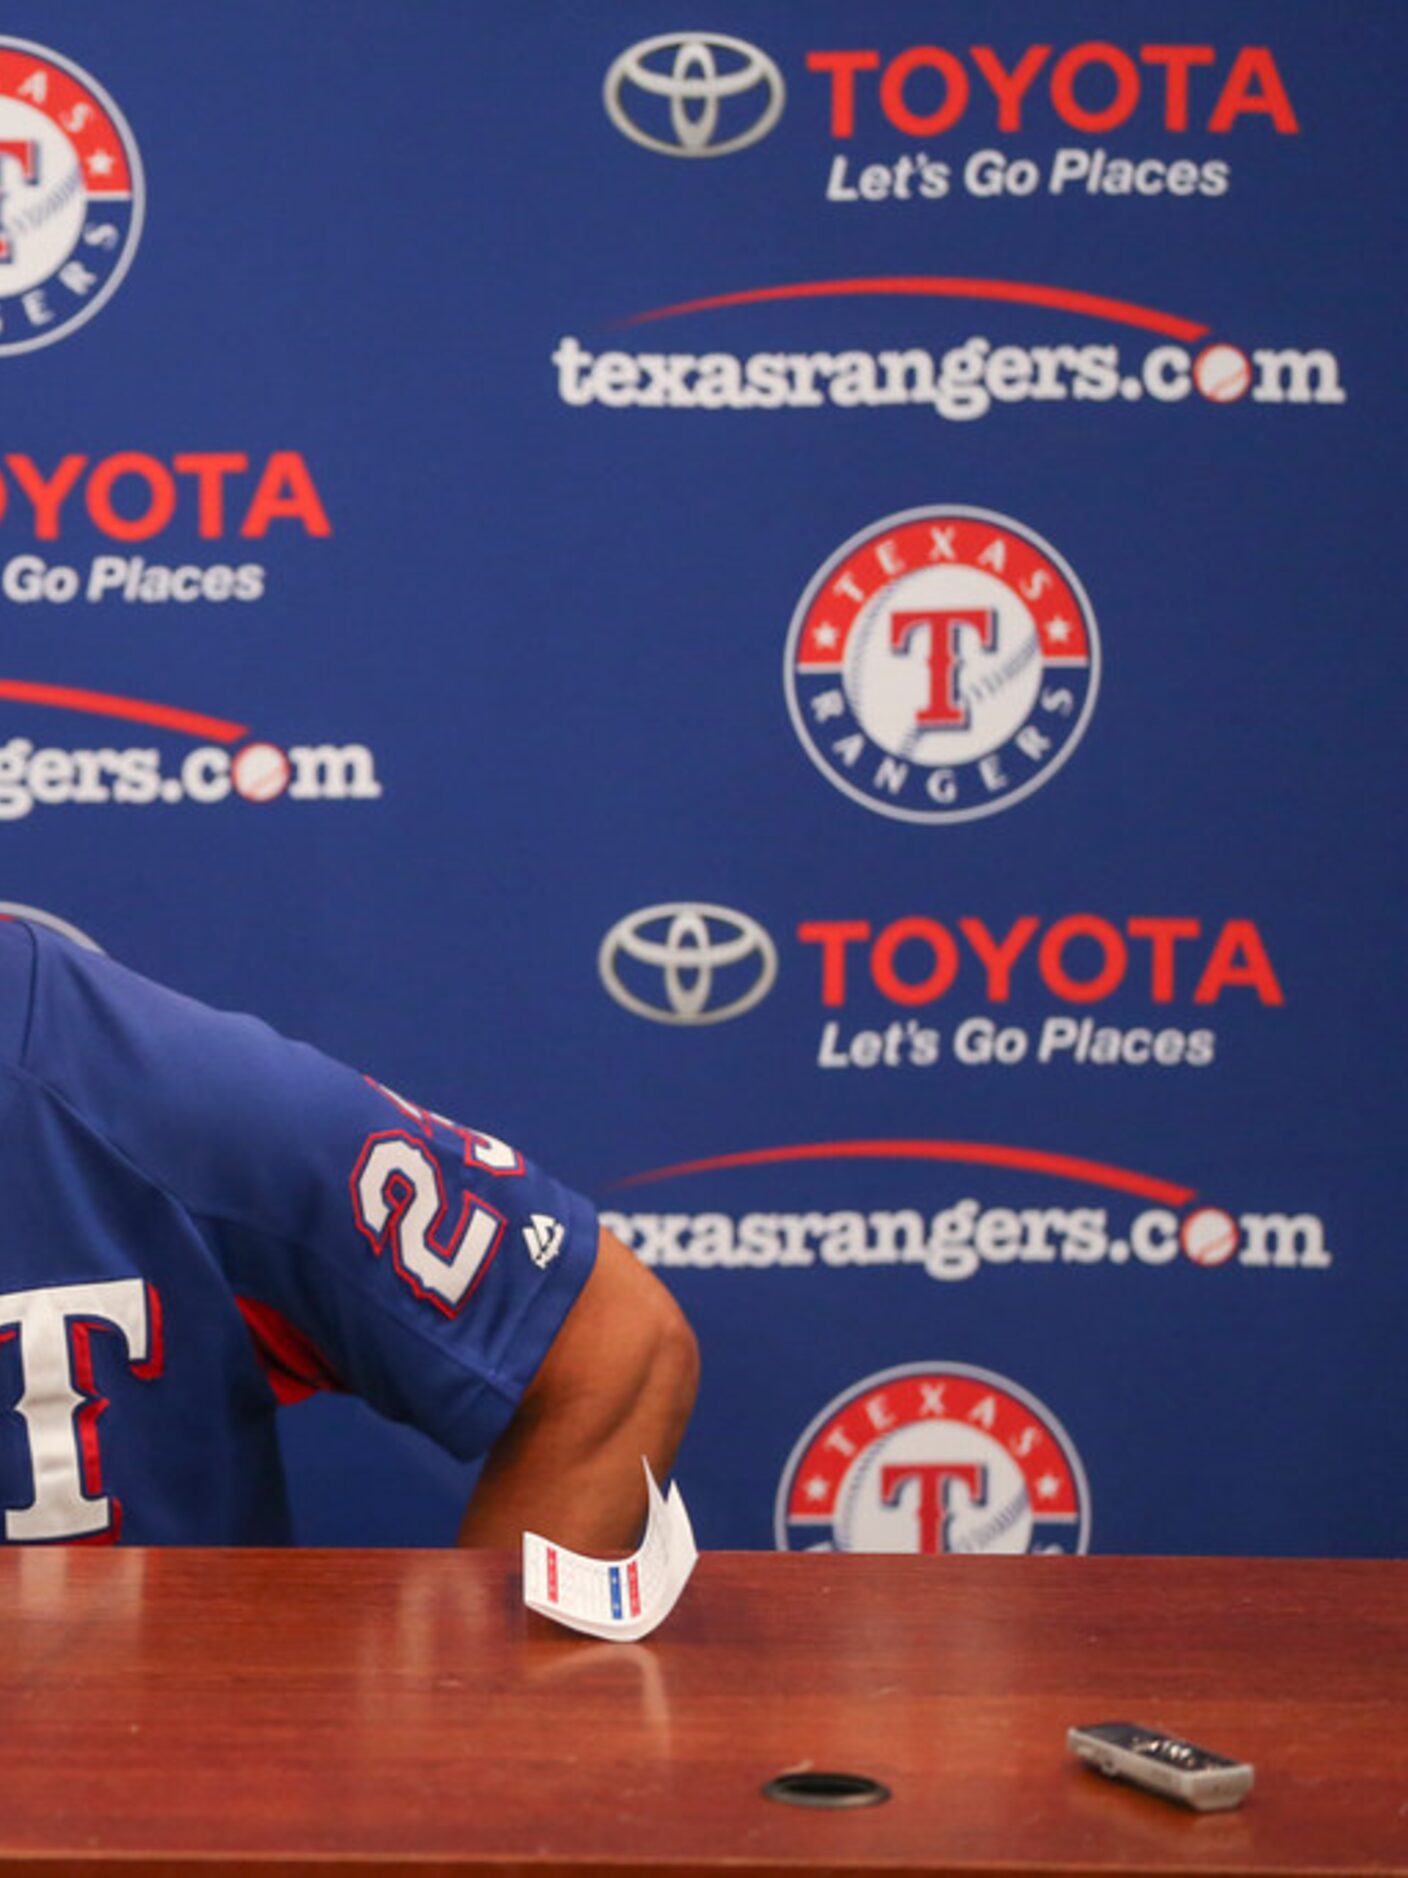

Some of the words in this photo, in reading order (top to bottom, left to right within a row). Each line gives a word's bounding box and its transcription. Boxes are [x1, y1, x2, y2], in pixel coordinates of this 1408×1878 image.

[807, 42, 1297, 137] TOYOTA
[827, 154, 949, 200] Let's
[965, 150, 1038, 196] Go
[1050, 149, 1227, 196] Places
[551, 336, 1346, 421] texasrangers.com
[3, 555, 78, 603] Go
[87, 556, 264, 603] Places
[832, 526, 1054, 602] TEXAS
[889, 608, 1000, 732] T
[809, 687, 1074, 804] RANGERS
[799, 915, 1283, 1006] TOYOTA
[819, 1021, 938, 1067] Let's
[954, 1018, 1027, 1063] Go
[1039, 1018, 1214, 1065] Places
[823, 1382, 1043, 1457] TEXAS
